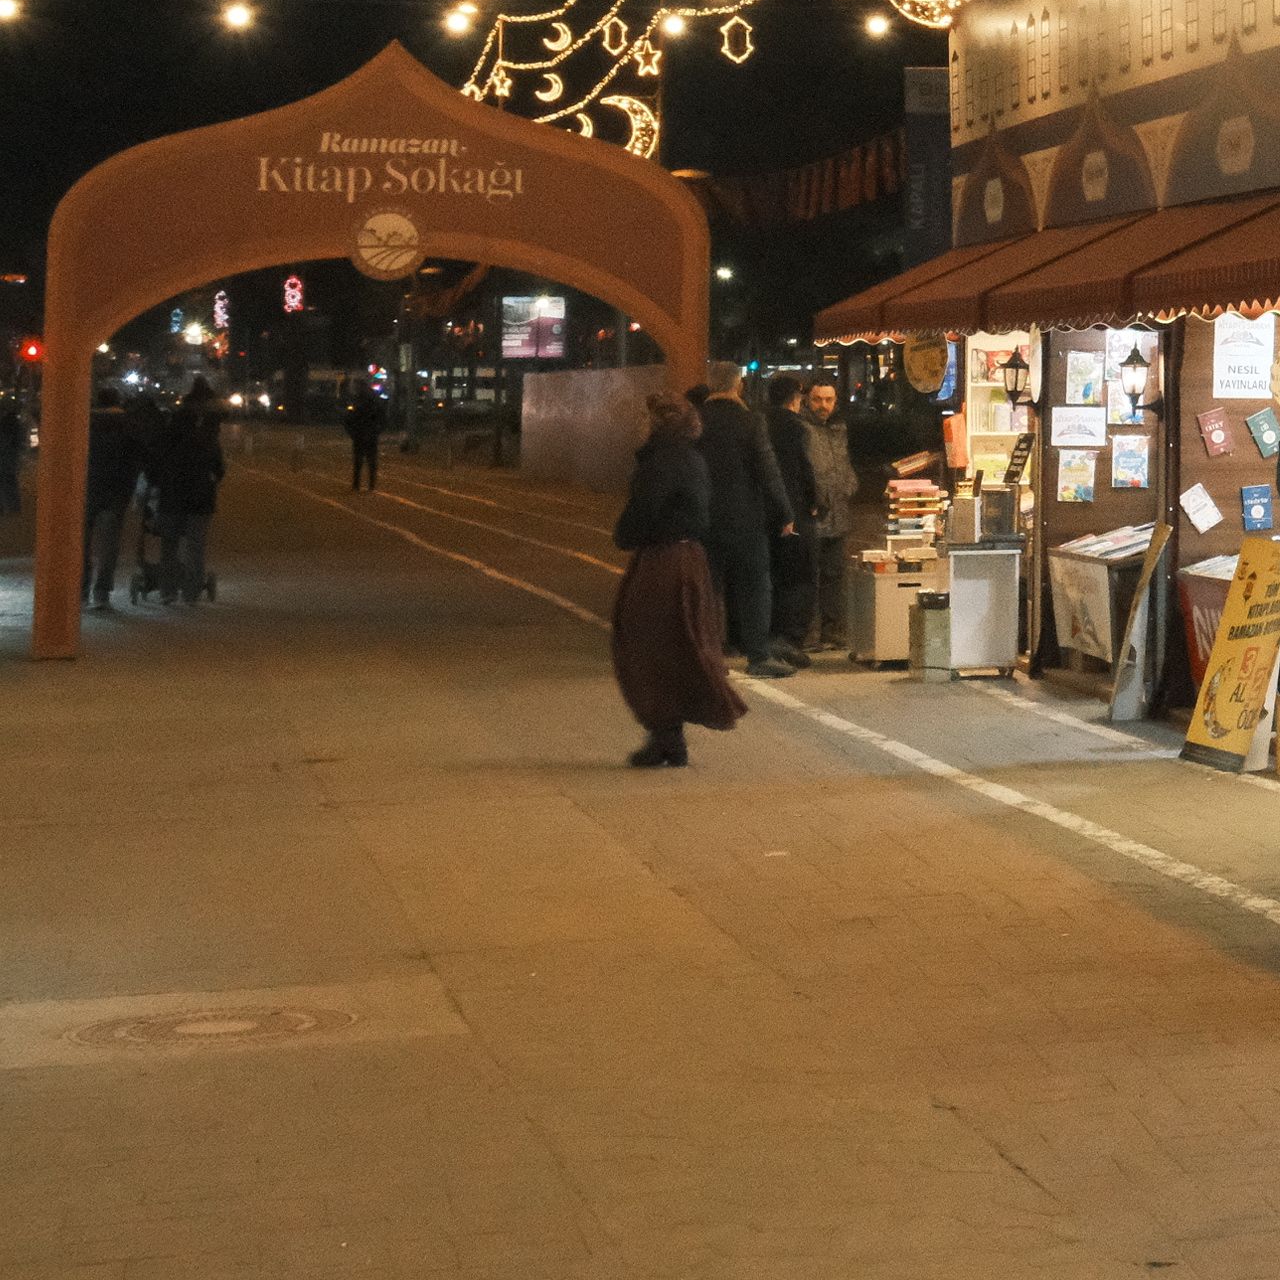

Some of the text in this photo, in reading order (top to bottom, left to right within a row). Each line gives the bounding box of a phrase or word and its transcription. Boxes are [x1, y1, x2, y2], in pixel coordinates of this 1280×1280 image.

[319, 132, 460, 156] Ramazan
[257, 157, 524, 204] Kitap Sokağı
[1220, 379, 1266, 390] YAYINLARI
